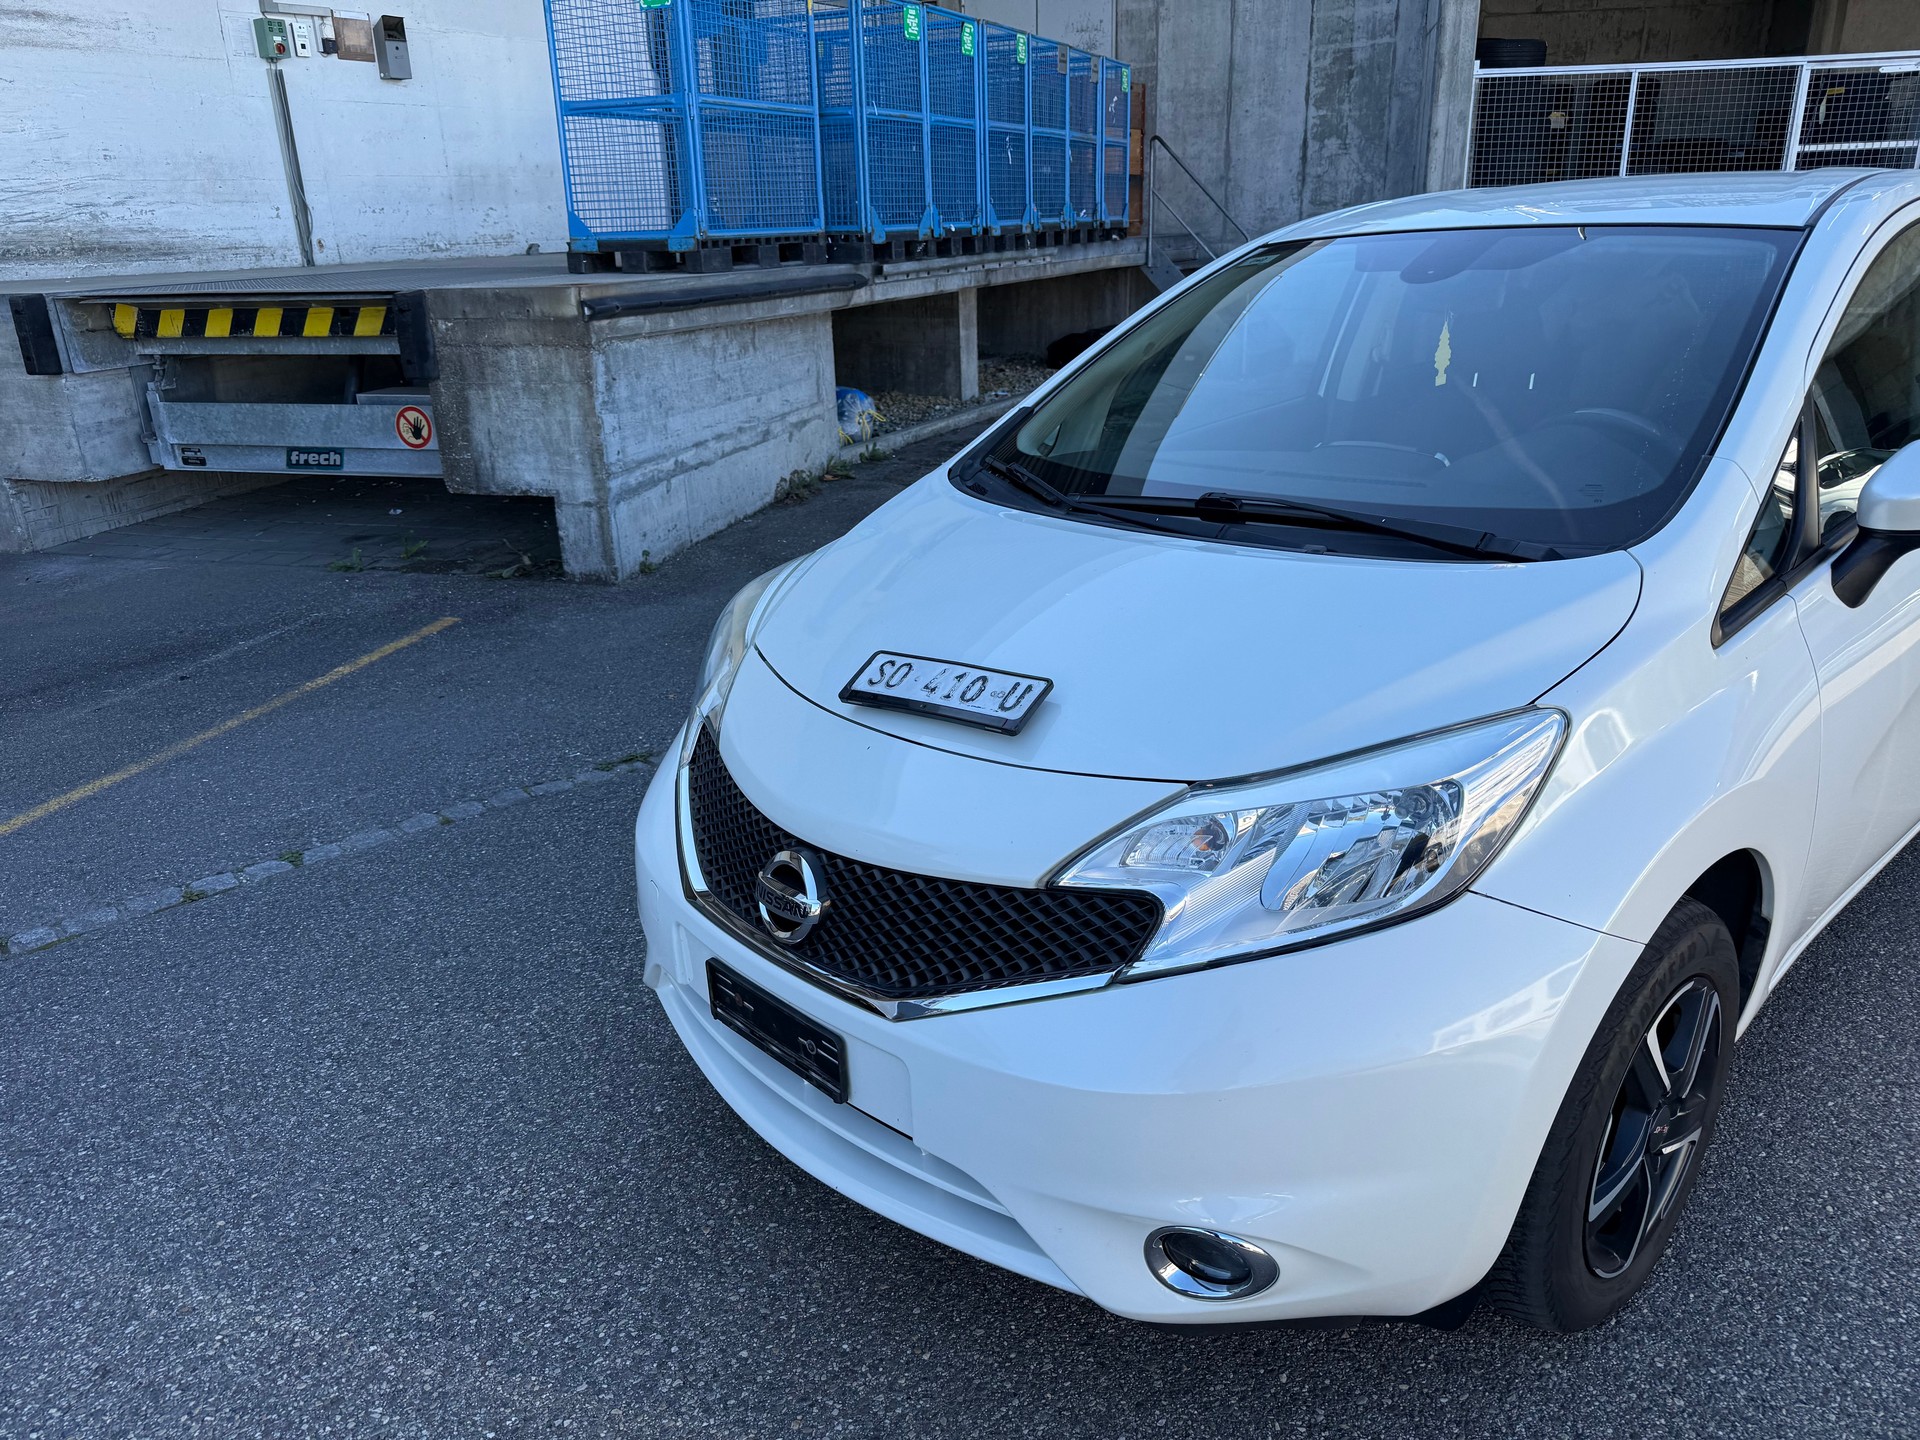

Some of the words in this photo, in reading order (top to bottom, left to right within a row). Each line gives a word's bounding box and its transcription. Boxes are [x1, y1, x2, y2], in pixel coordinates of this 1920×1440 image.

[290, 451, 341, 465] frech
[867, 659, 913, 689] SO
[920, 667, 989, 704] 410
[997, 681, 1034, 712] U
[756, 883, 810, 919] NISSAN
